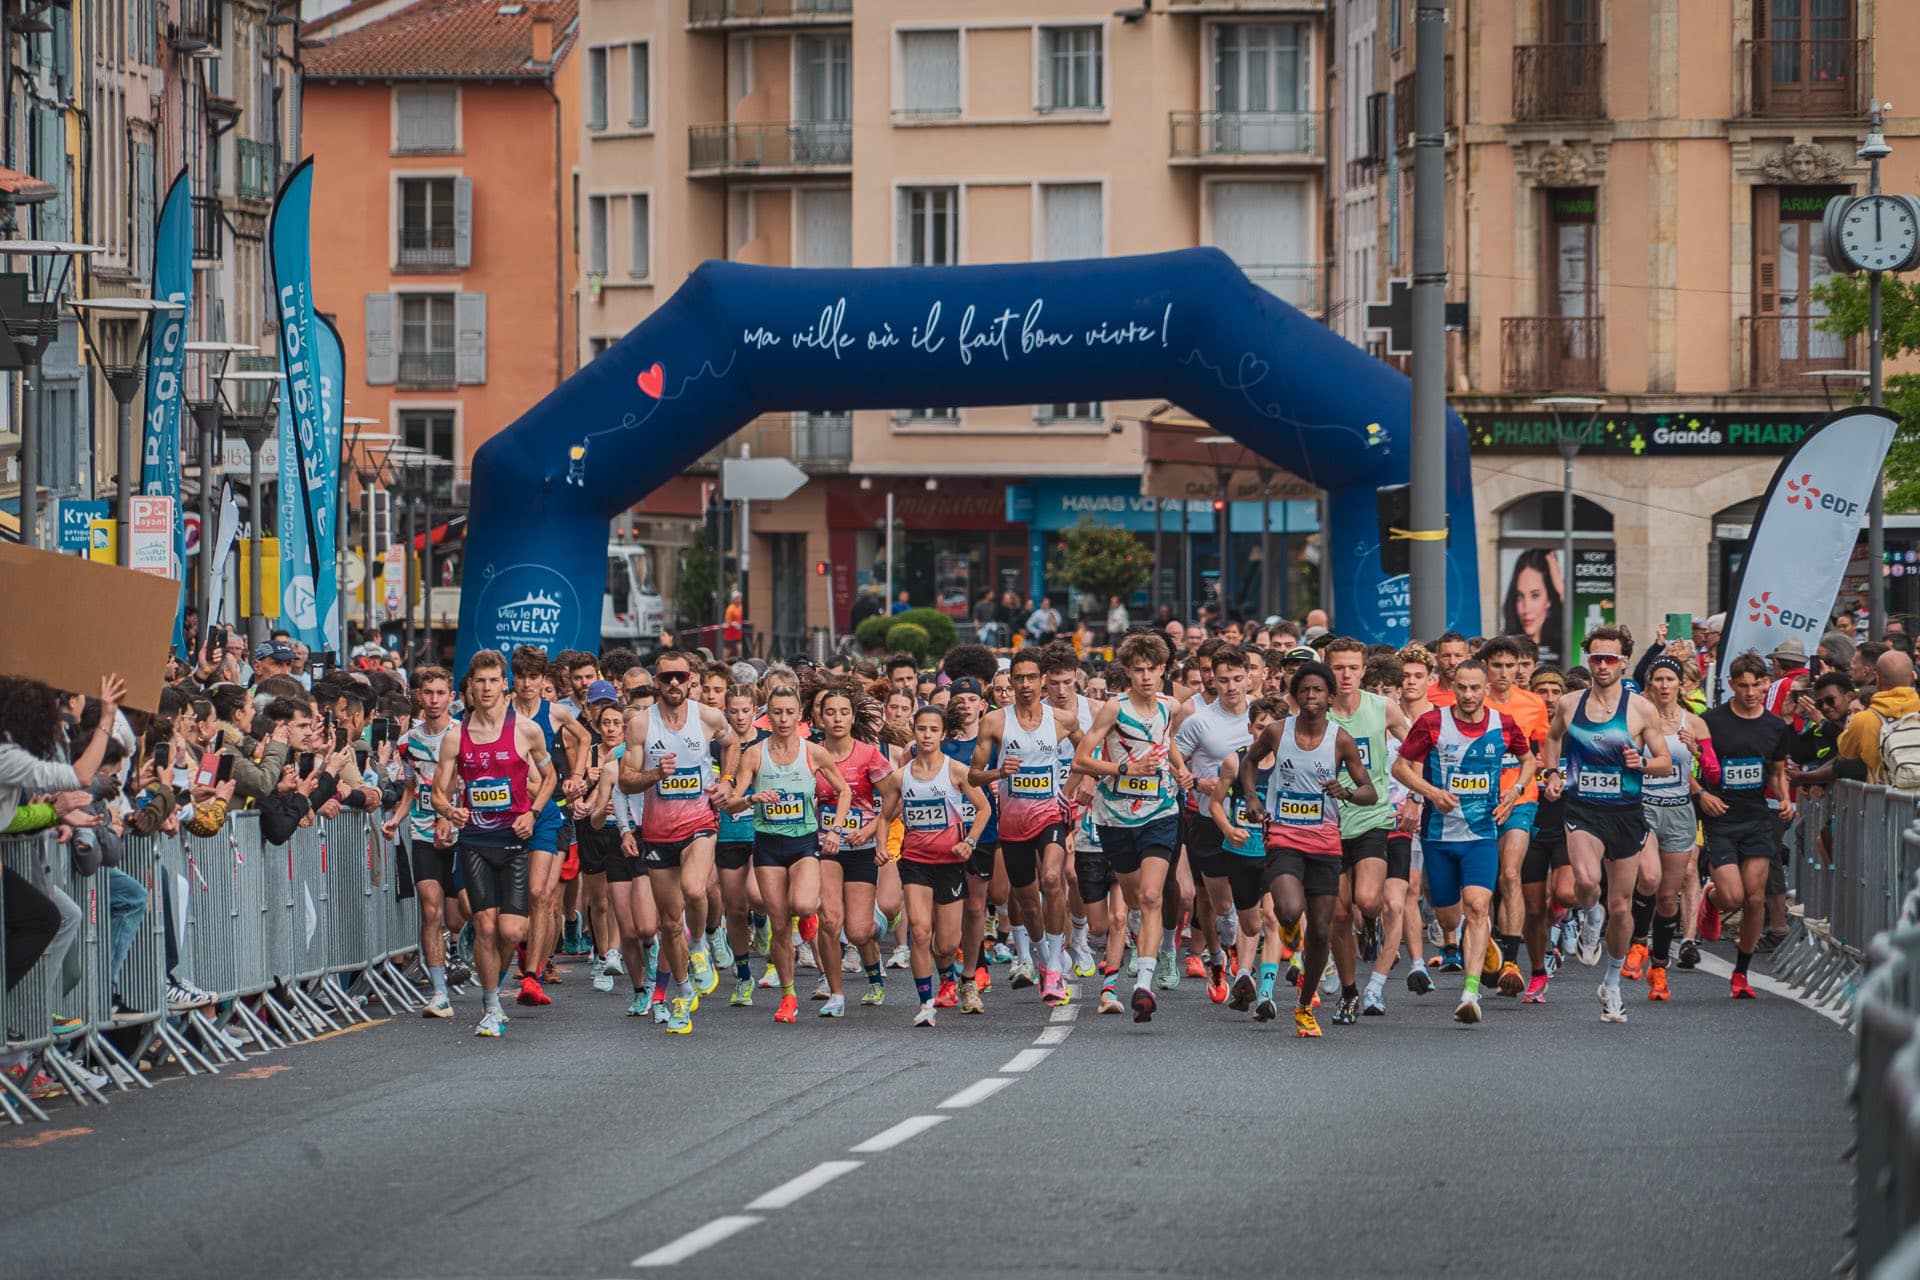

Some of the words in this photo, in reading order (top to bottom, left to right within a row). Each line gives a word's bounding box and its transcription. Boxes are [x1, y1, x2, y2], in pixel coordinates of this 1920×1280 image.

[744, 327, 780, 350] ma
[792, 297, 855, 360] ville
[867, 322, 899, 350] où
[911, 300, 945, 353] il
[959, 304, 1020, 366] fait
[1021, 298, 1073, 354] bon
[145, 292, 186, 465] Région
[1653, 426, 1722, 444] Grande
[1062, 496, 1126, 512] HAVAS
[64, 508, 102, 529] Krys
[1576, 563, 1614, 576] DERCOS
[1906, 567, 1917, 575] 19
[1377, 599, 1393, 608] en
[520, 607, 531, 619] le
[532, 607, 561, 621] PUY
[496, 622, 510, 632] en
[510, 619, 560, 635] VELAY
[388, 633, 398, 647] P
[1580, 774, 1619, 788] 5134
[1726, 768, 1761, 780] 5165
[661, 776, 699, 790] 5002
[1013, 776, 1050, 788] 5003
[1128, 777, 1149, 791] 68
[1451, 776, 1488, 789] 5010
[472, 788, 508, 802] 5005
[1660, 796, 1689, 806] PRO
[765, 803, 801, 816] 5001
[906, 808, 944, 821] 5212
[1280, 802, 1320, 815] 5004
